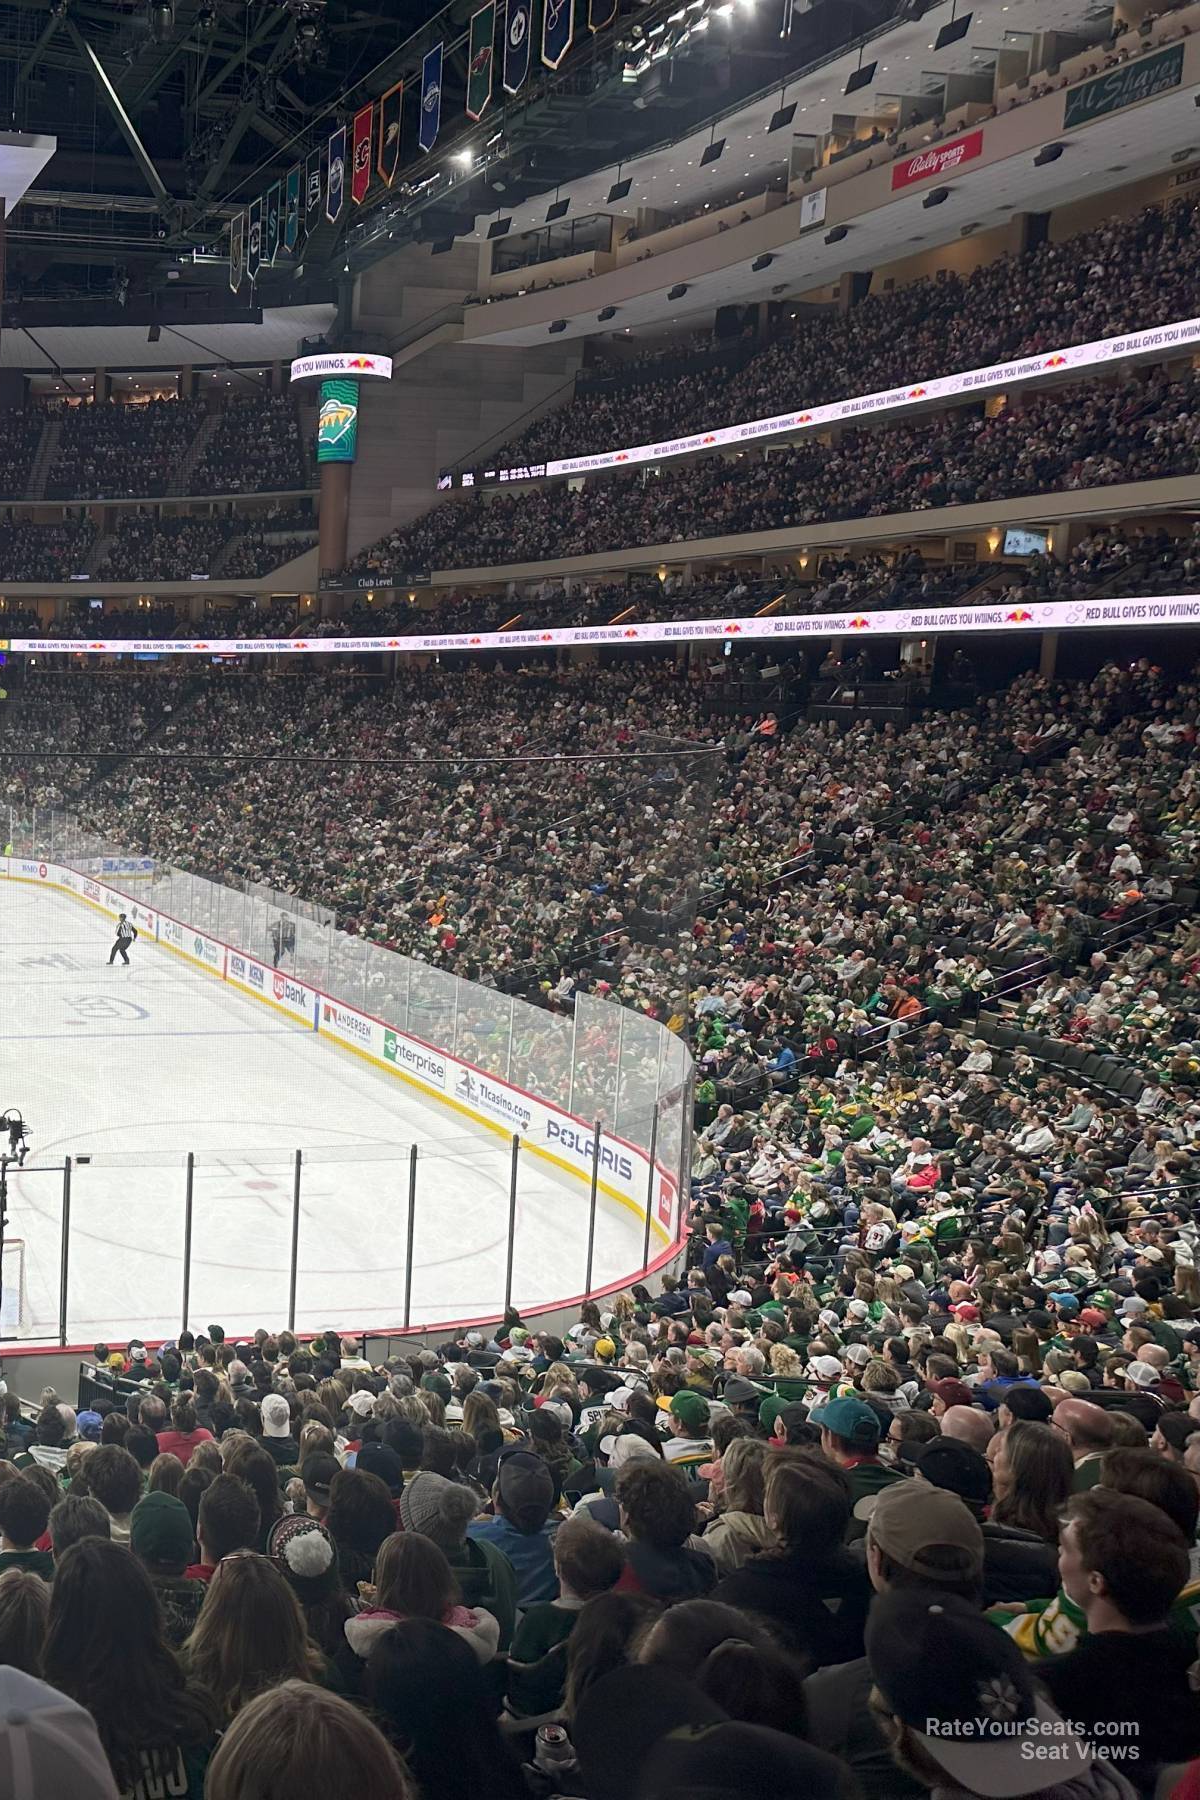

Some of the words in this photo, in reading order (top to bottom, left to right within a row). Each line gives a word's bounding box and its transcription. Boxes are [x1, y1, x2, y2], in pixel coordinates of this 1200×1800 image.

[908, 151, 938, 176] Bally
[940, 145, 965, 163] SPORTS
[1113, 341, 1125, 352] RED
[1126, 338, 1140, 350] BULL
[1143, 333, 1162, 346] GIVES
[1164, 330, 1178, 342] YOU
[302, 362, 313, 372] YOU
[963, 376, 972, 387] RED
[974, 373, 986, 385] BULL
[987, 370, 1003, 382] GIVES
[1004, 367, 1016, 378] YOU
[358, 579, 373, 587] Club
[376, 578, 392, 586] Level
[911, 616, 922, 626] RED
[924, 615, 938, 625] BULL
[939, 614, 957, 625] GIVES
[959, 613, 972, 624] YOU
[1086, 608, 1100, 619] RED
[1102, 607, 1120, 618] BULL
[1122, 606, 1146, 618] GIVES
[1148, 604, 1166, 617] YOU
[683, 627, 694, 635] GIVES
[695, 626, 703, 634] YOU
[774, 622, 783, 632] RED
[785, 622, 795, 631] BULL
[797, 621, 811, 631] GIVES
[812, 621, 822, 630] YOU
[285, 981, 306, 1007] bank
[338, 1012, 371, 1037] ANDERSEN
[385, 1038, 443, 1078] enterprise
[547, 1120, 632, 1180] POLARIS
